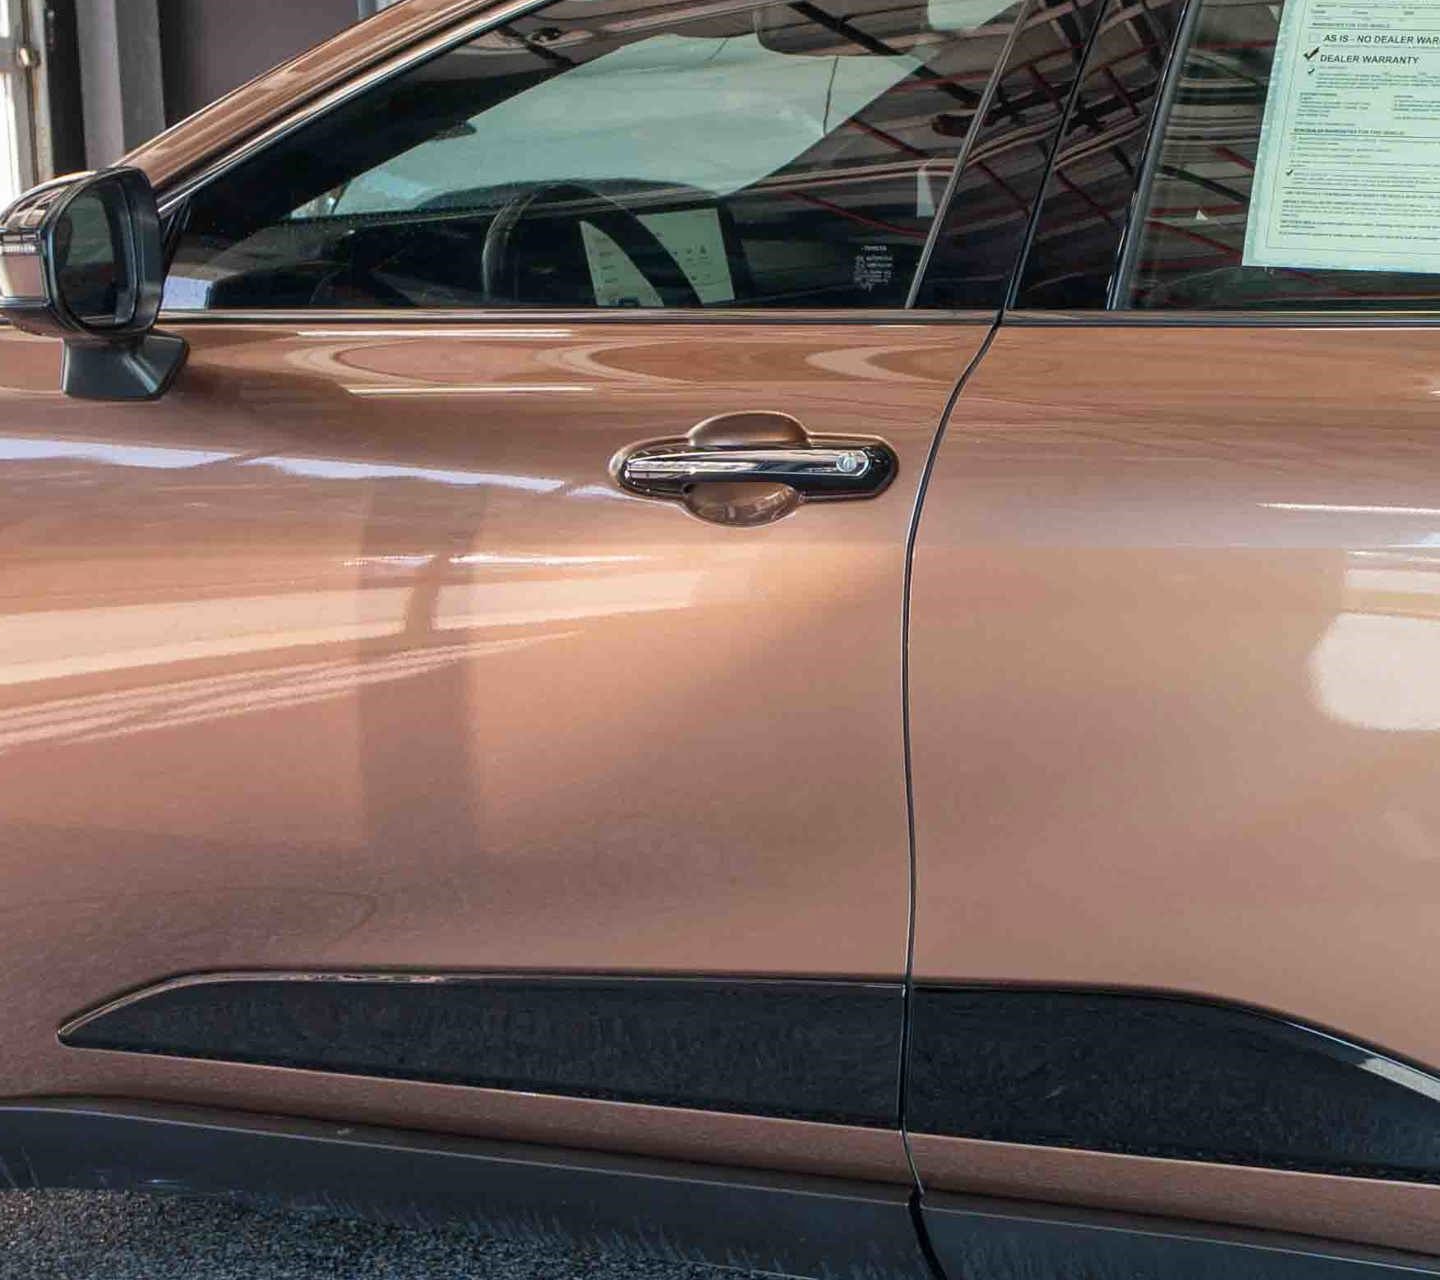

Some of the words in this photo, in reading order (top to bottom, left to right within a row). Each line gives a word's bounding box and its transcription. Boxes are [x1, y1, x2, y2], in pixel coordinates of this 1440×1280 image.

[1323, 35, 1338, 43] AS
[1339, 35, 1349, 43] IS
[1357, 35, 1372, 43] NO
[1373, 36, 1414, 44] DEALER
[1320, 55, 1360, 64] DEALER
[1362, 55, 1420, 65] WARRANTY
